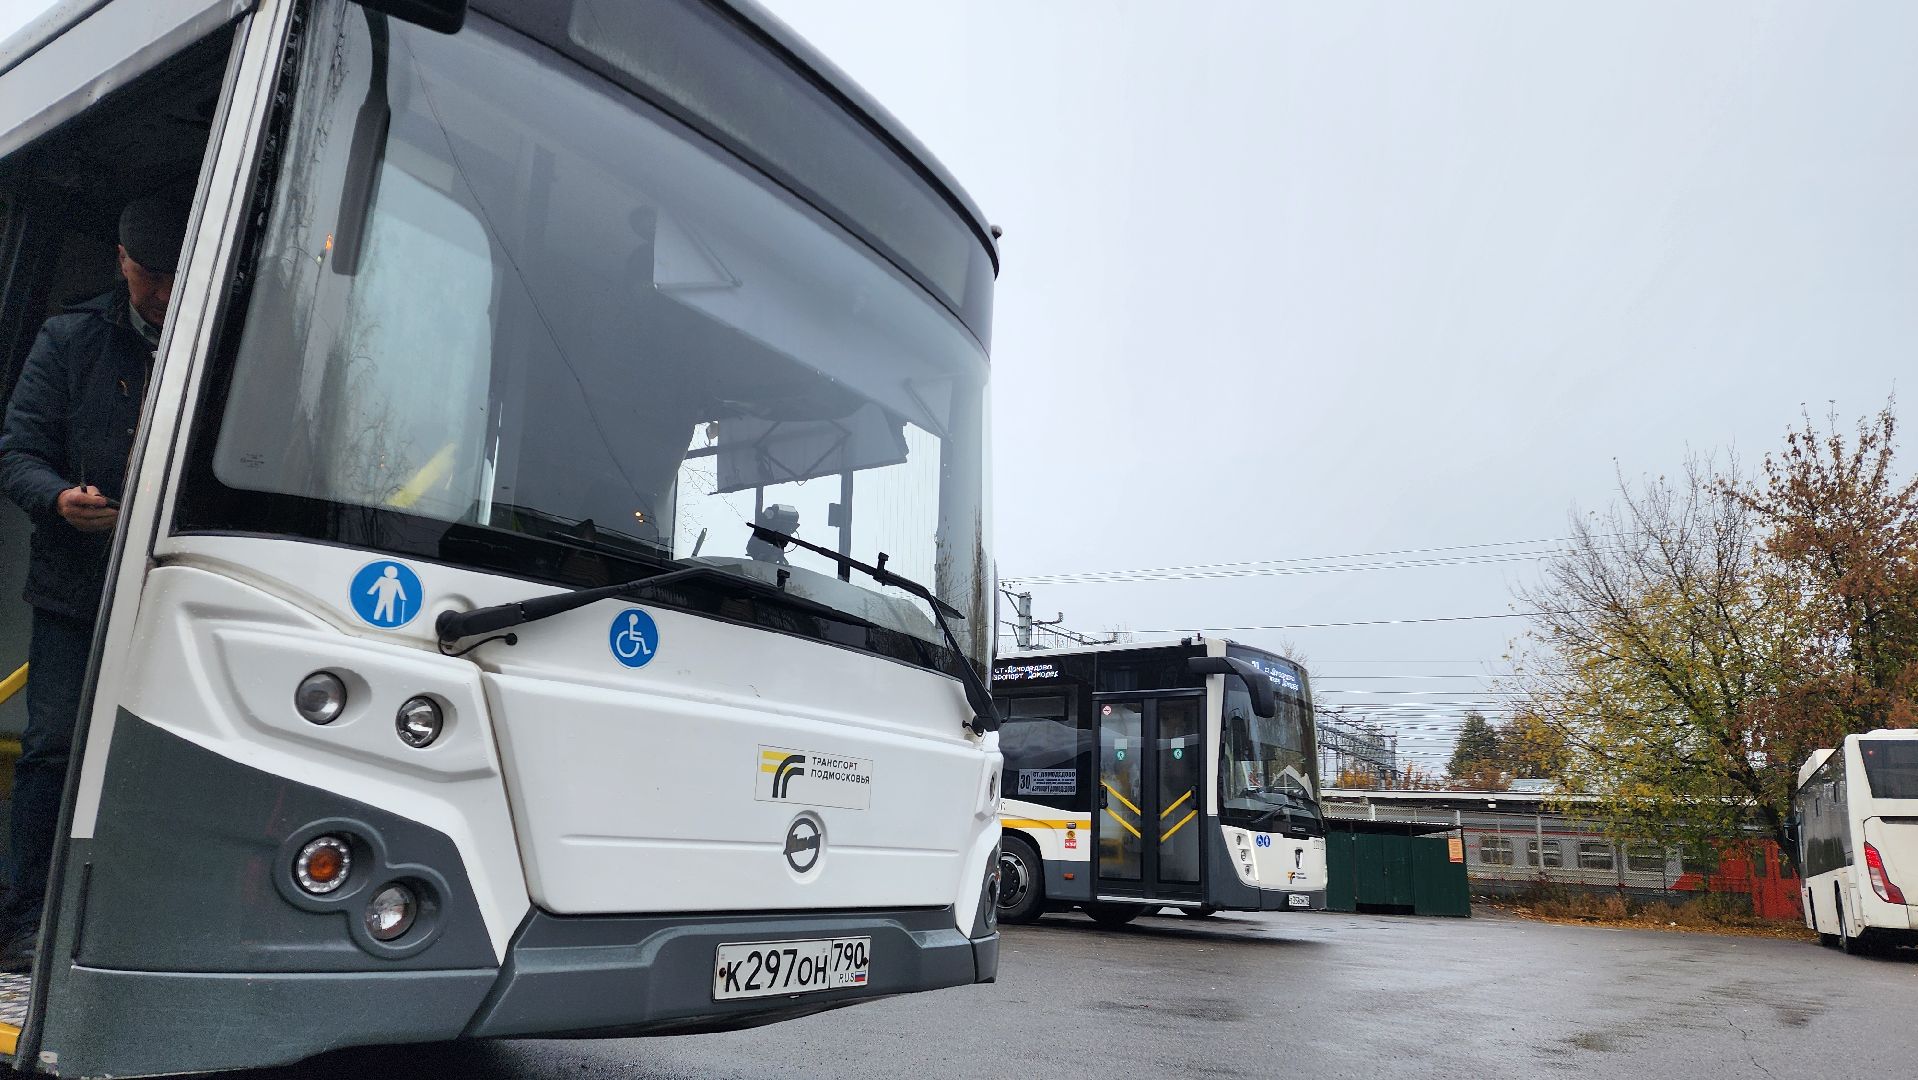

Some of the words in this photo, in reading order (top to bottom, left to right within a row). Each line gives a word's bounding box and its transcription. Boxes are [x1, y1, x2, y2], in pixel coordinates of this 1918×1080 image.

[812, 757, 858, 771] ТРАНСПОРТ
[811, 769, 870, 785] ПОДМОСКОВЬЯ
[1020, 774, 1031, 790] 30
[725, 949, 828, 992] К297ОН
[834, 942, 865, 972] 790
[839, 972, 855, 983] RUS
